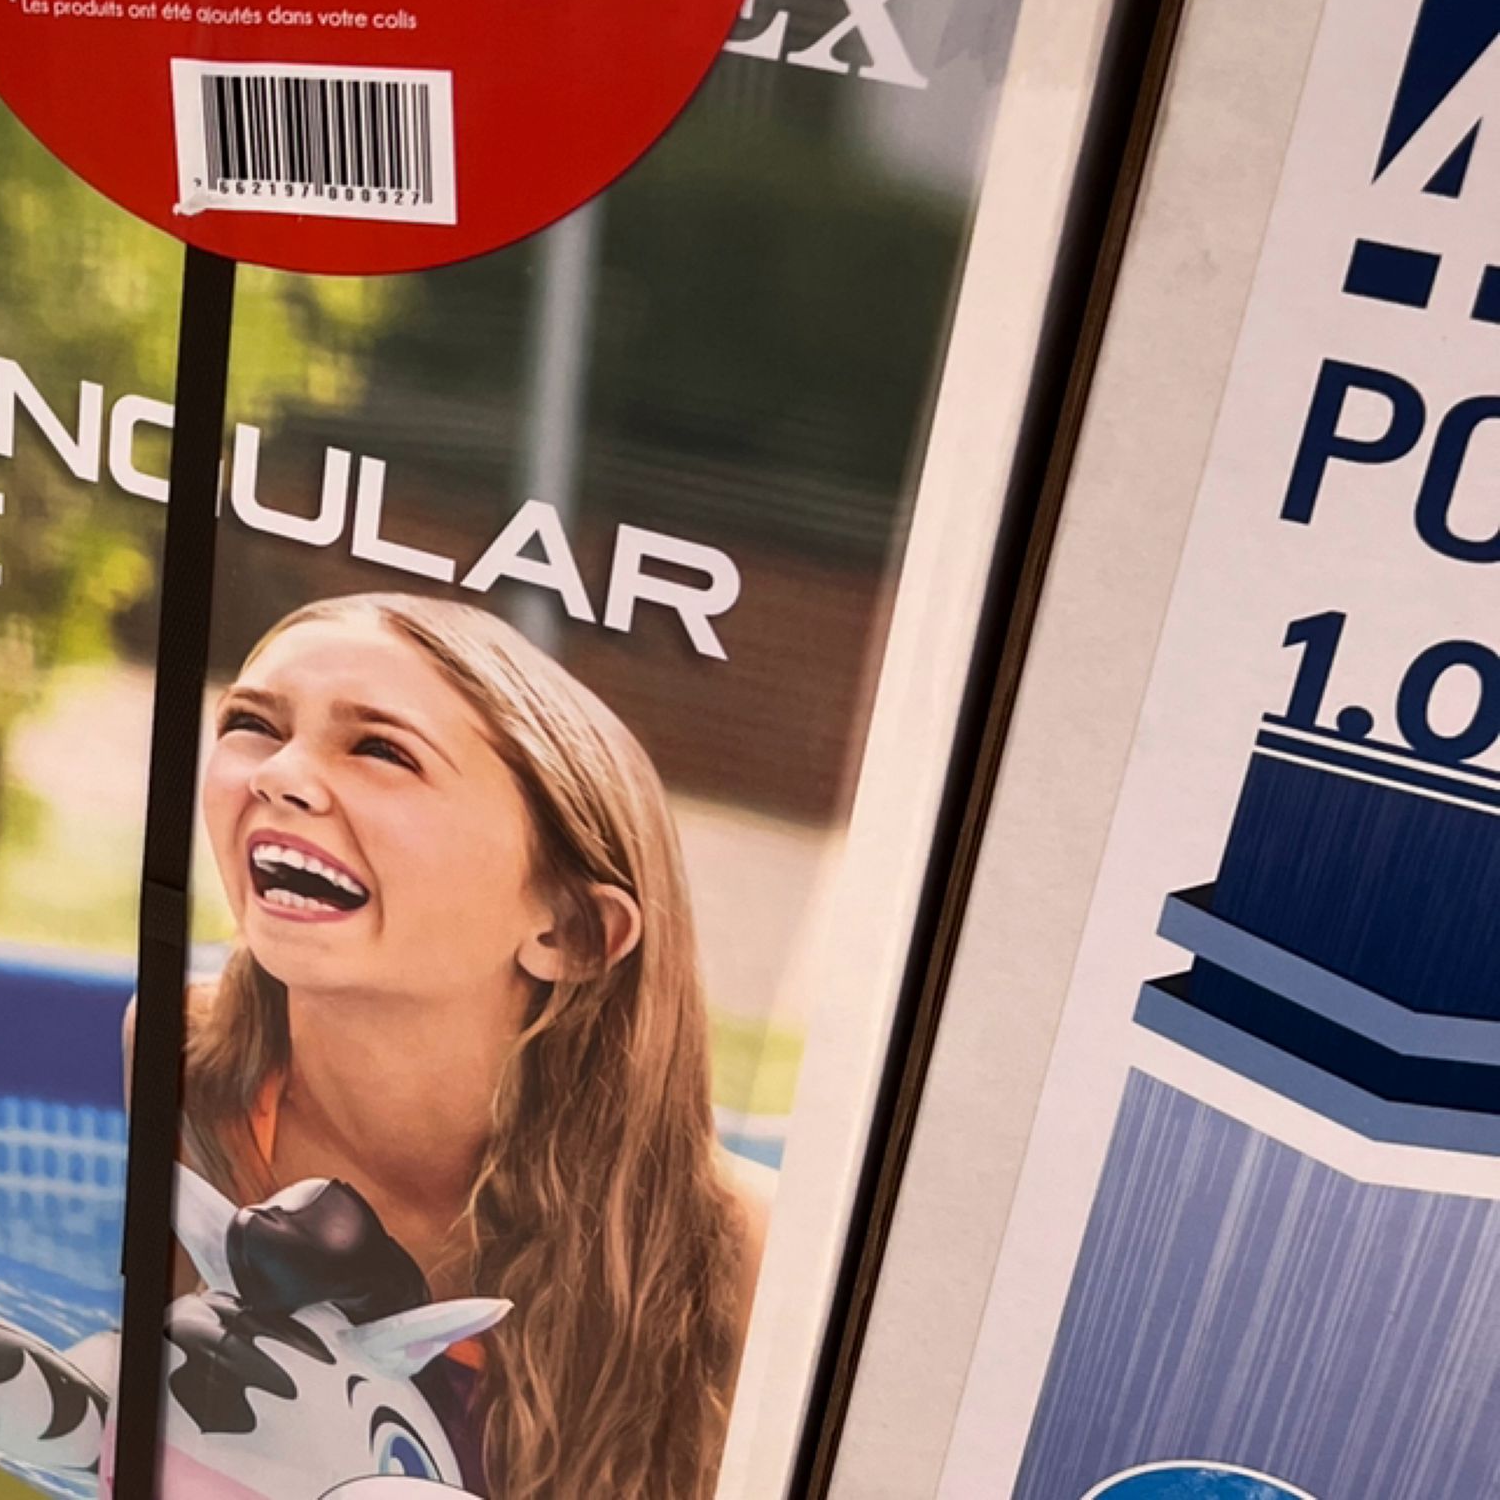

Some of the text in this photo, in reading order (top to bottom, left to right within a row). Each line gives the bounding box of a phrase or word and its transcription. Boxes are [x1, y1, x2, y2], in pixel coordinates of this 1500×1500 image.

[128, 1, 158, 19] ont
[161, 1, 192, 21] été
[196, 3, 262, 25] ajoutés
[267, 5, 312, 26] dans
[318, 8, 368, 28] votre
[373, 9, 418, 30] colis
